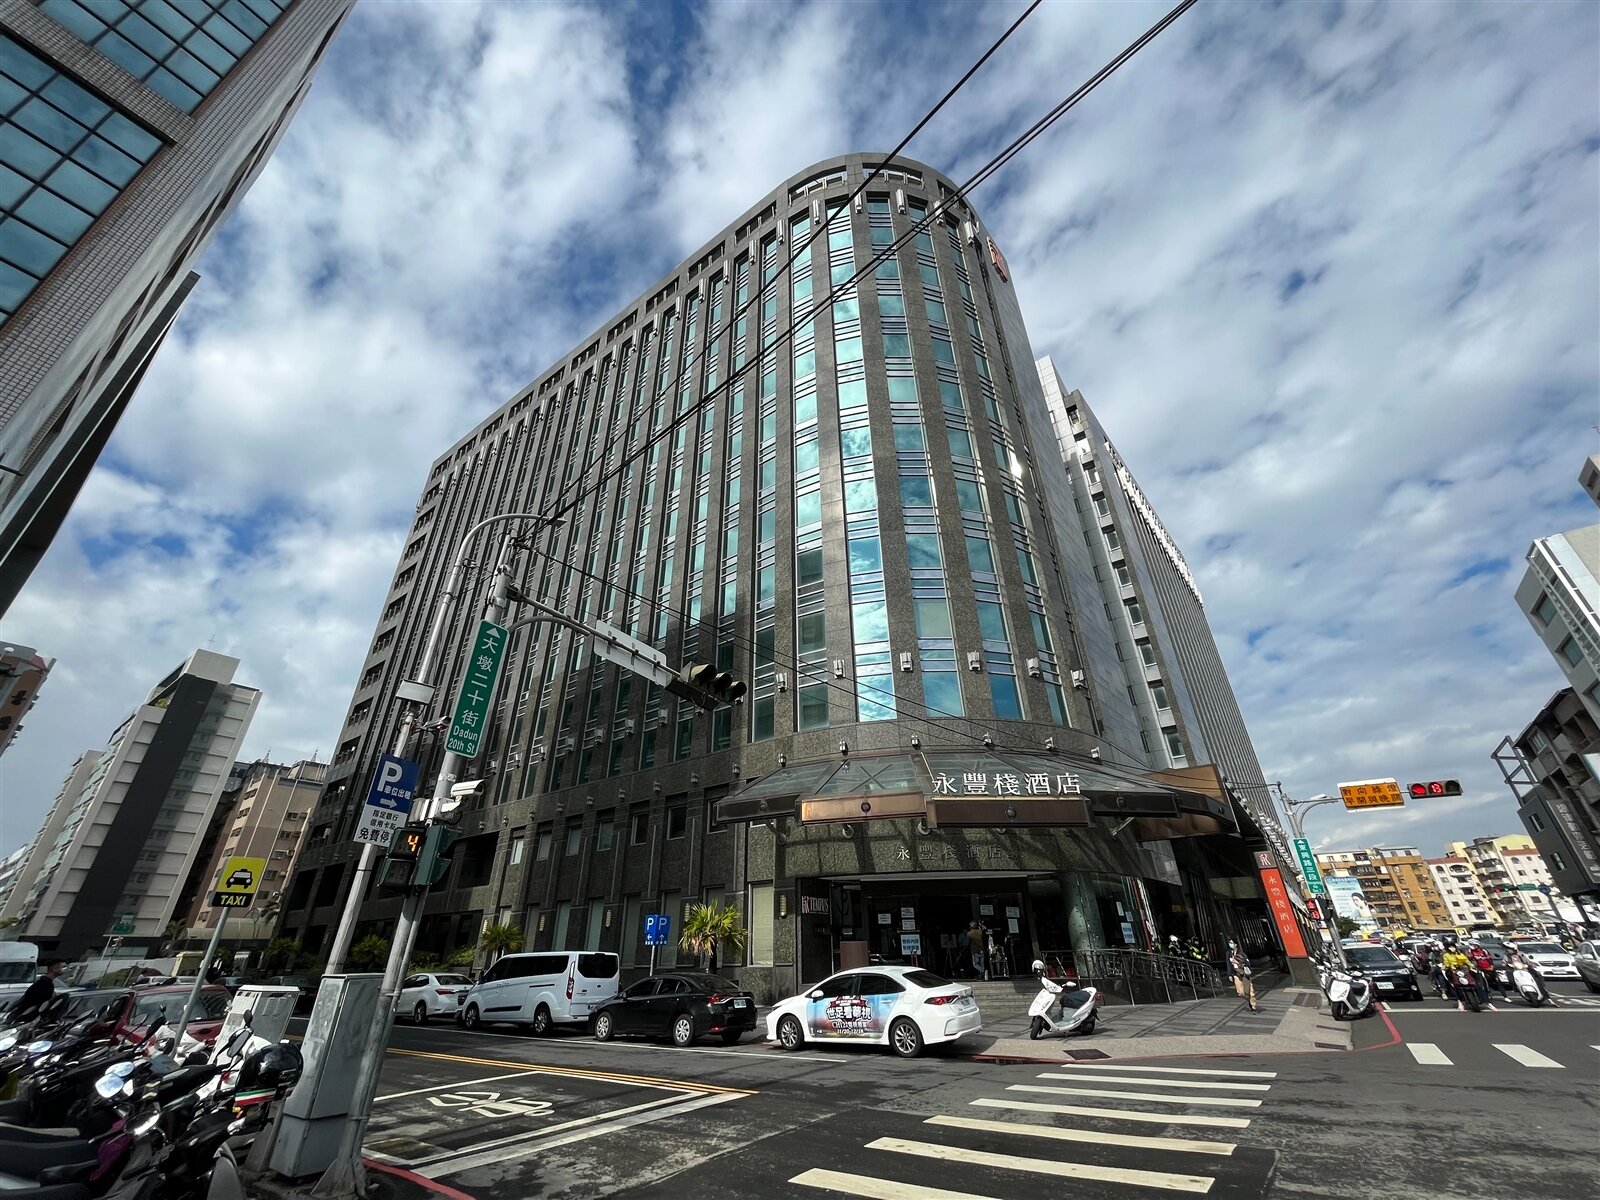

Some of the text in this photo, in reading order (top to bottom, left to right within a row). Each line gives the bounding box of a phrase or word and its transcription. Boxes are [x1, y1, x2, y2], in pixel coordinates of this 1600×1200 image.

[462, 637, 498, 727] 大墩二十街
[453, 725, 478, 741] Dadun
[447, 738, 475, 754] 20th St
[377, 760, 402, 792] P
[931, 772, 1081, 795] 永豐棧酒店
[358, 827, 393, 844] 免費停
[407, 835, 419, 851] 4
[220, 895, 247, 906] TAXI
[1268, 875, 1294, 934] 永豐棧酒店
[647, 917, 667, 930] P P
[826, 1006, 872, 1020] 世足看華視
